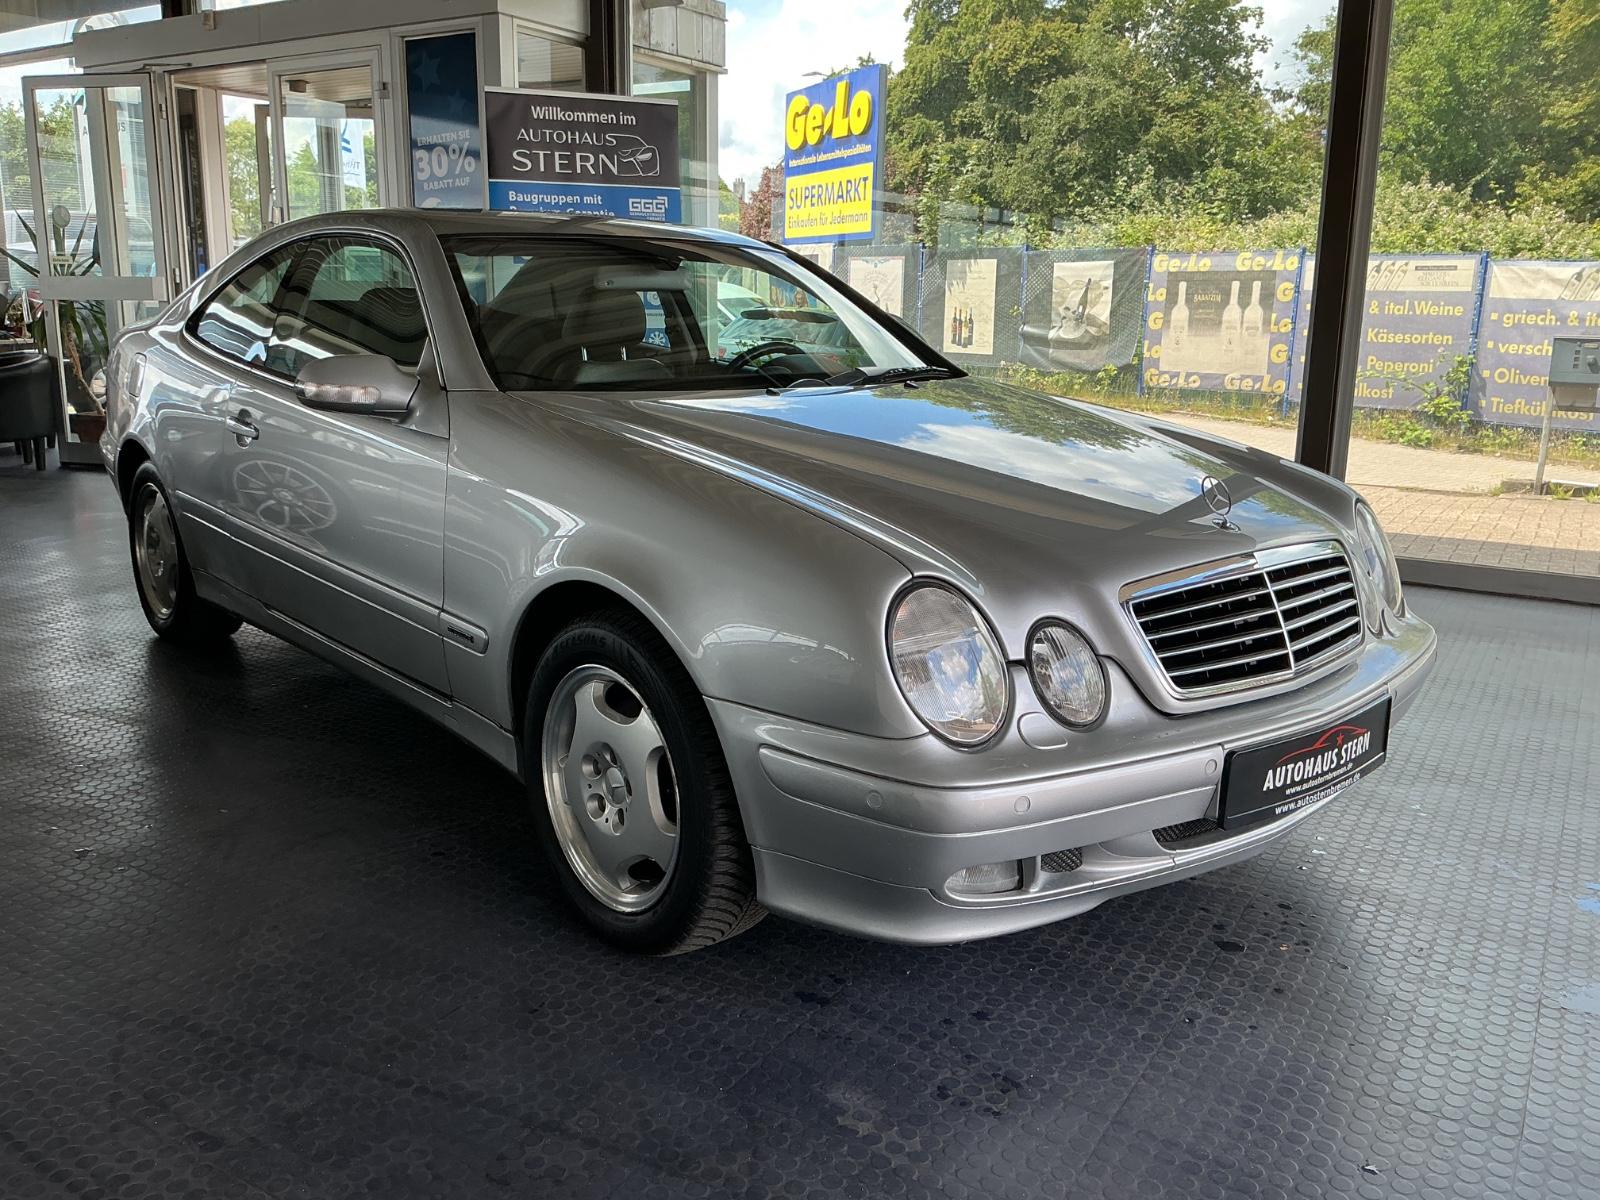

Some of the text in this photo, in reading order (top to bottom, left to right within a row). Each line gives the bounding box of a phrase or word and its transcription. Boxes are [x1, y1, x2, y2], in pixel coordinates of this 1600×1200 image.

[531, 106, 636, 125] Willkommen im
[417, 128, 471, 146] ERHALTEN SIE
[517, 129, 617, 146] AUTOHAUS
[415, 141, 476, 181] 30%
[512, 149, 618, 175] STERN
[424, 176, 470, 191] RABATT AUF
[789, 176, 869, 210] SUPERMARKT
[508, 191, 602, 205] Baugruppen mit
[788, 210, 868, 229] Einkaufen für Jedermann
[1369, 300, 1379, 315] &
[1503, 309, 1600, 327] griech. & it
[1367, 327, 1453, 345] Käsesorten
[1366, 355, 1434, 375] Peperoni
[1262, 731, 1371, 792] AUTOHAUS STERN
[1285, 762, 1353, 795] www.autosternbremen.de
[1275, 772, 1361, 815] www.autosternbremen.de
